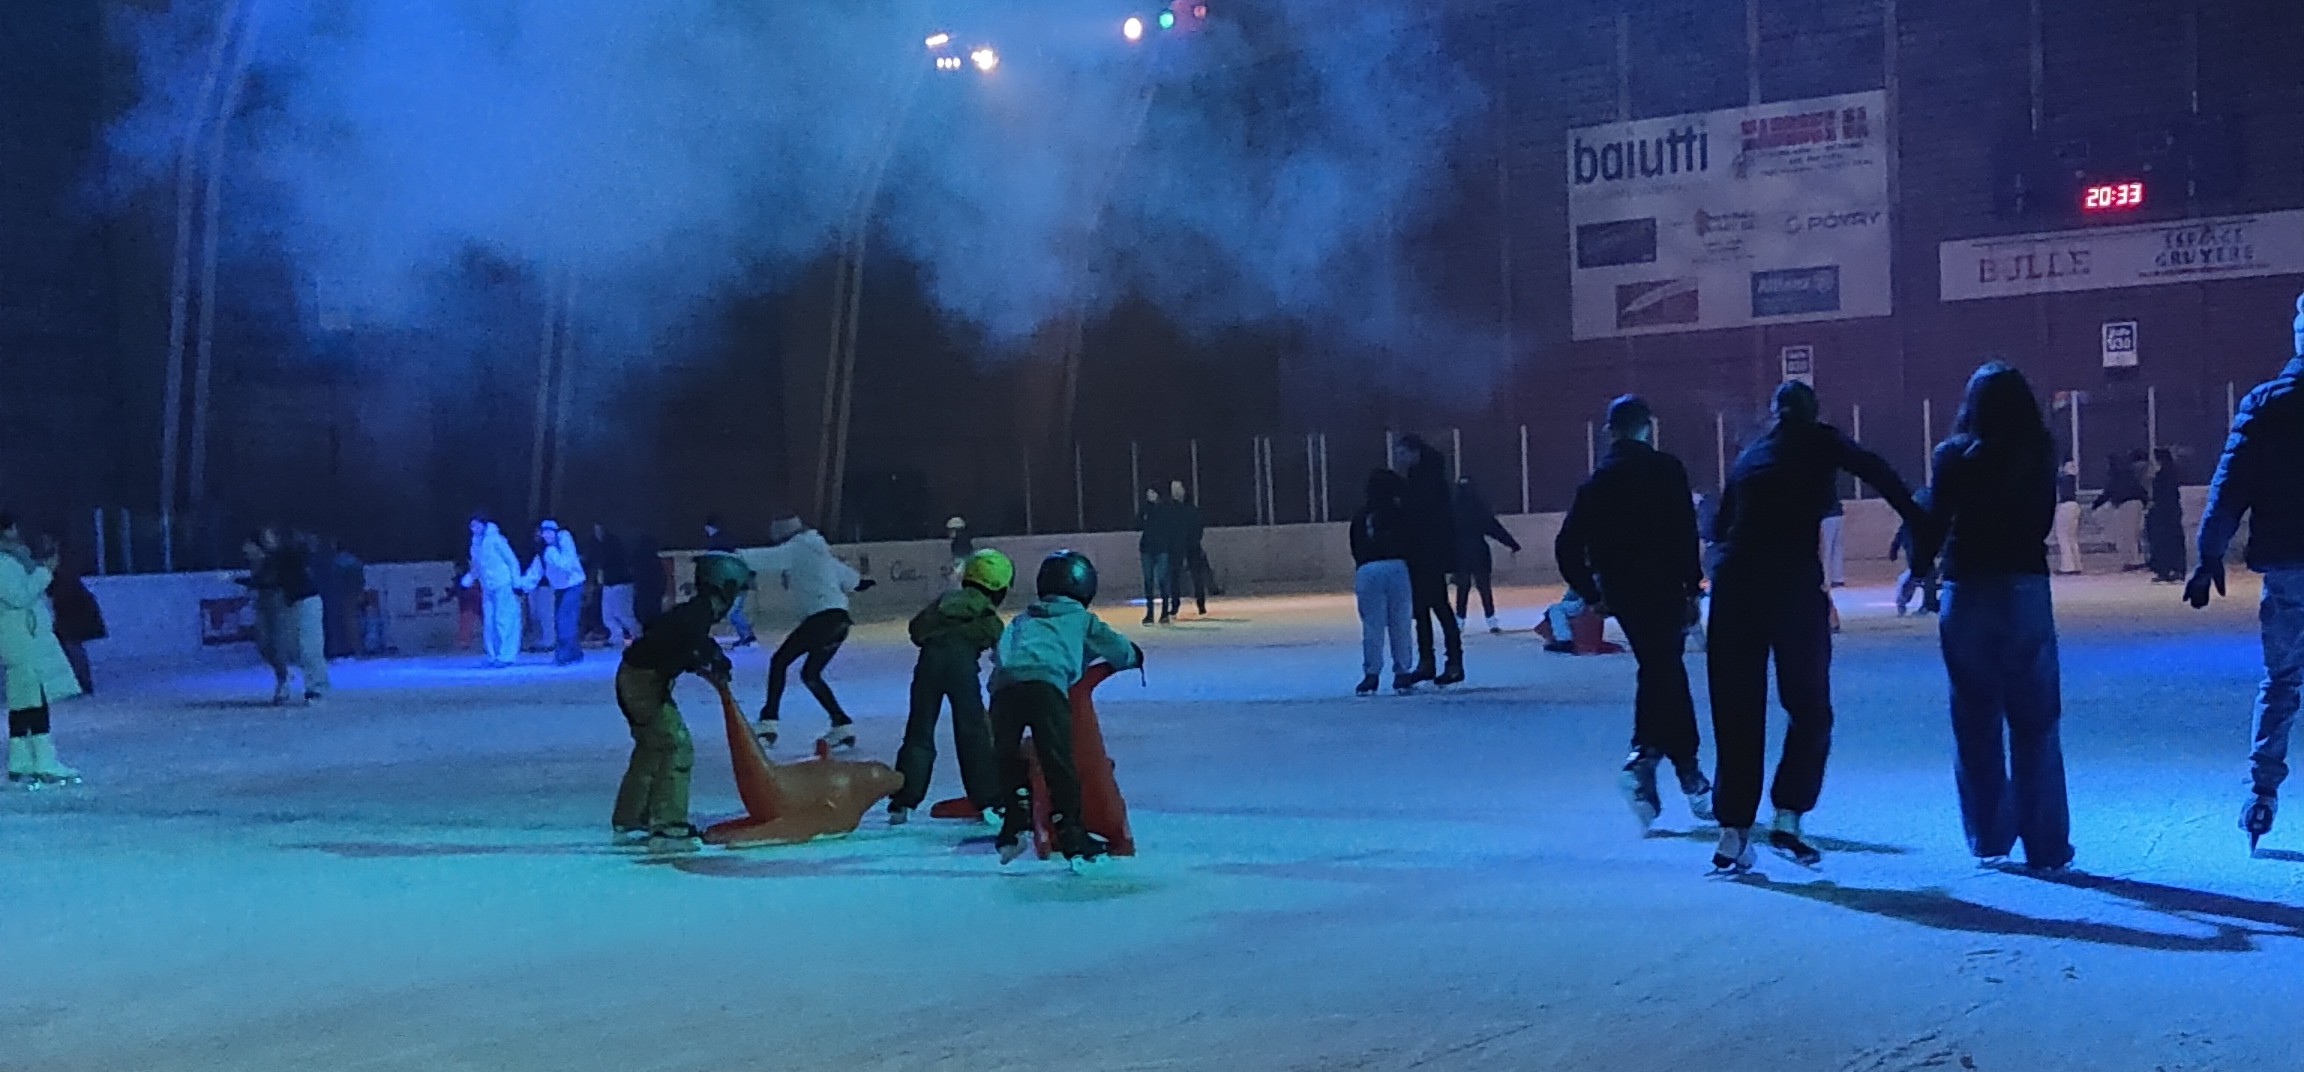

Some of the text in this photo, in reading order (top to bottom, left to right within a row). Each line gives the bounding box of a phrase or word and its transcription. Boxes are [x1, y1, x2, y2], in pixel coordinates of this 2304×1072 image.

[1573, 122, 1708, 186] baiutti
[2084, 182, 2143, 208] 20:33
[1978, 250, 2092, 284] BULLE
